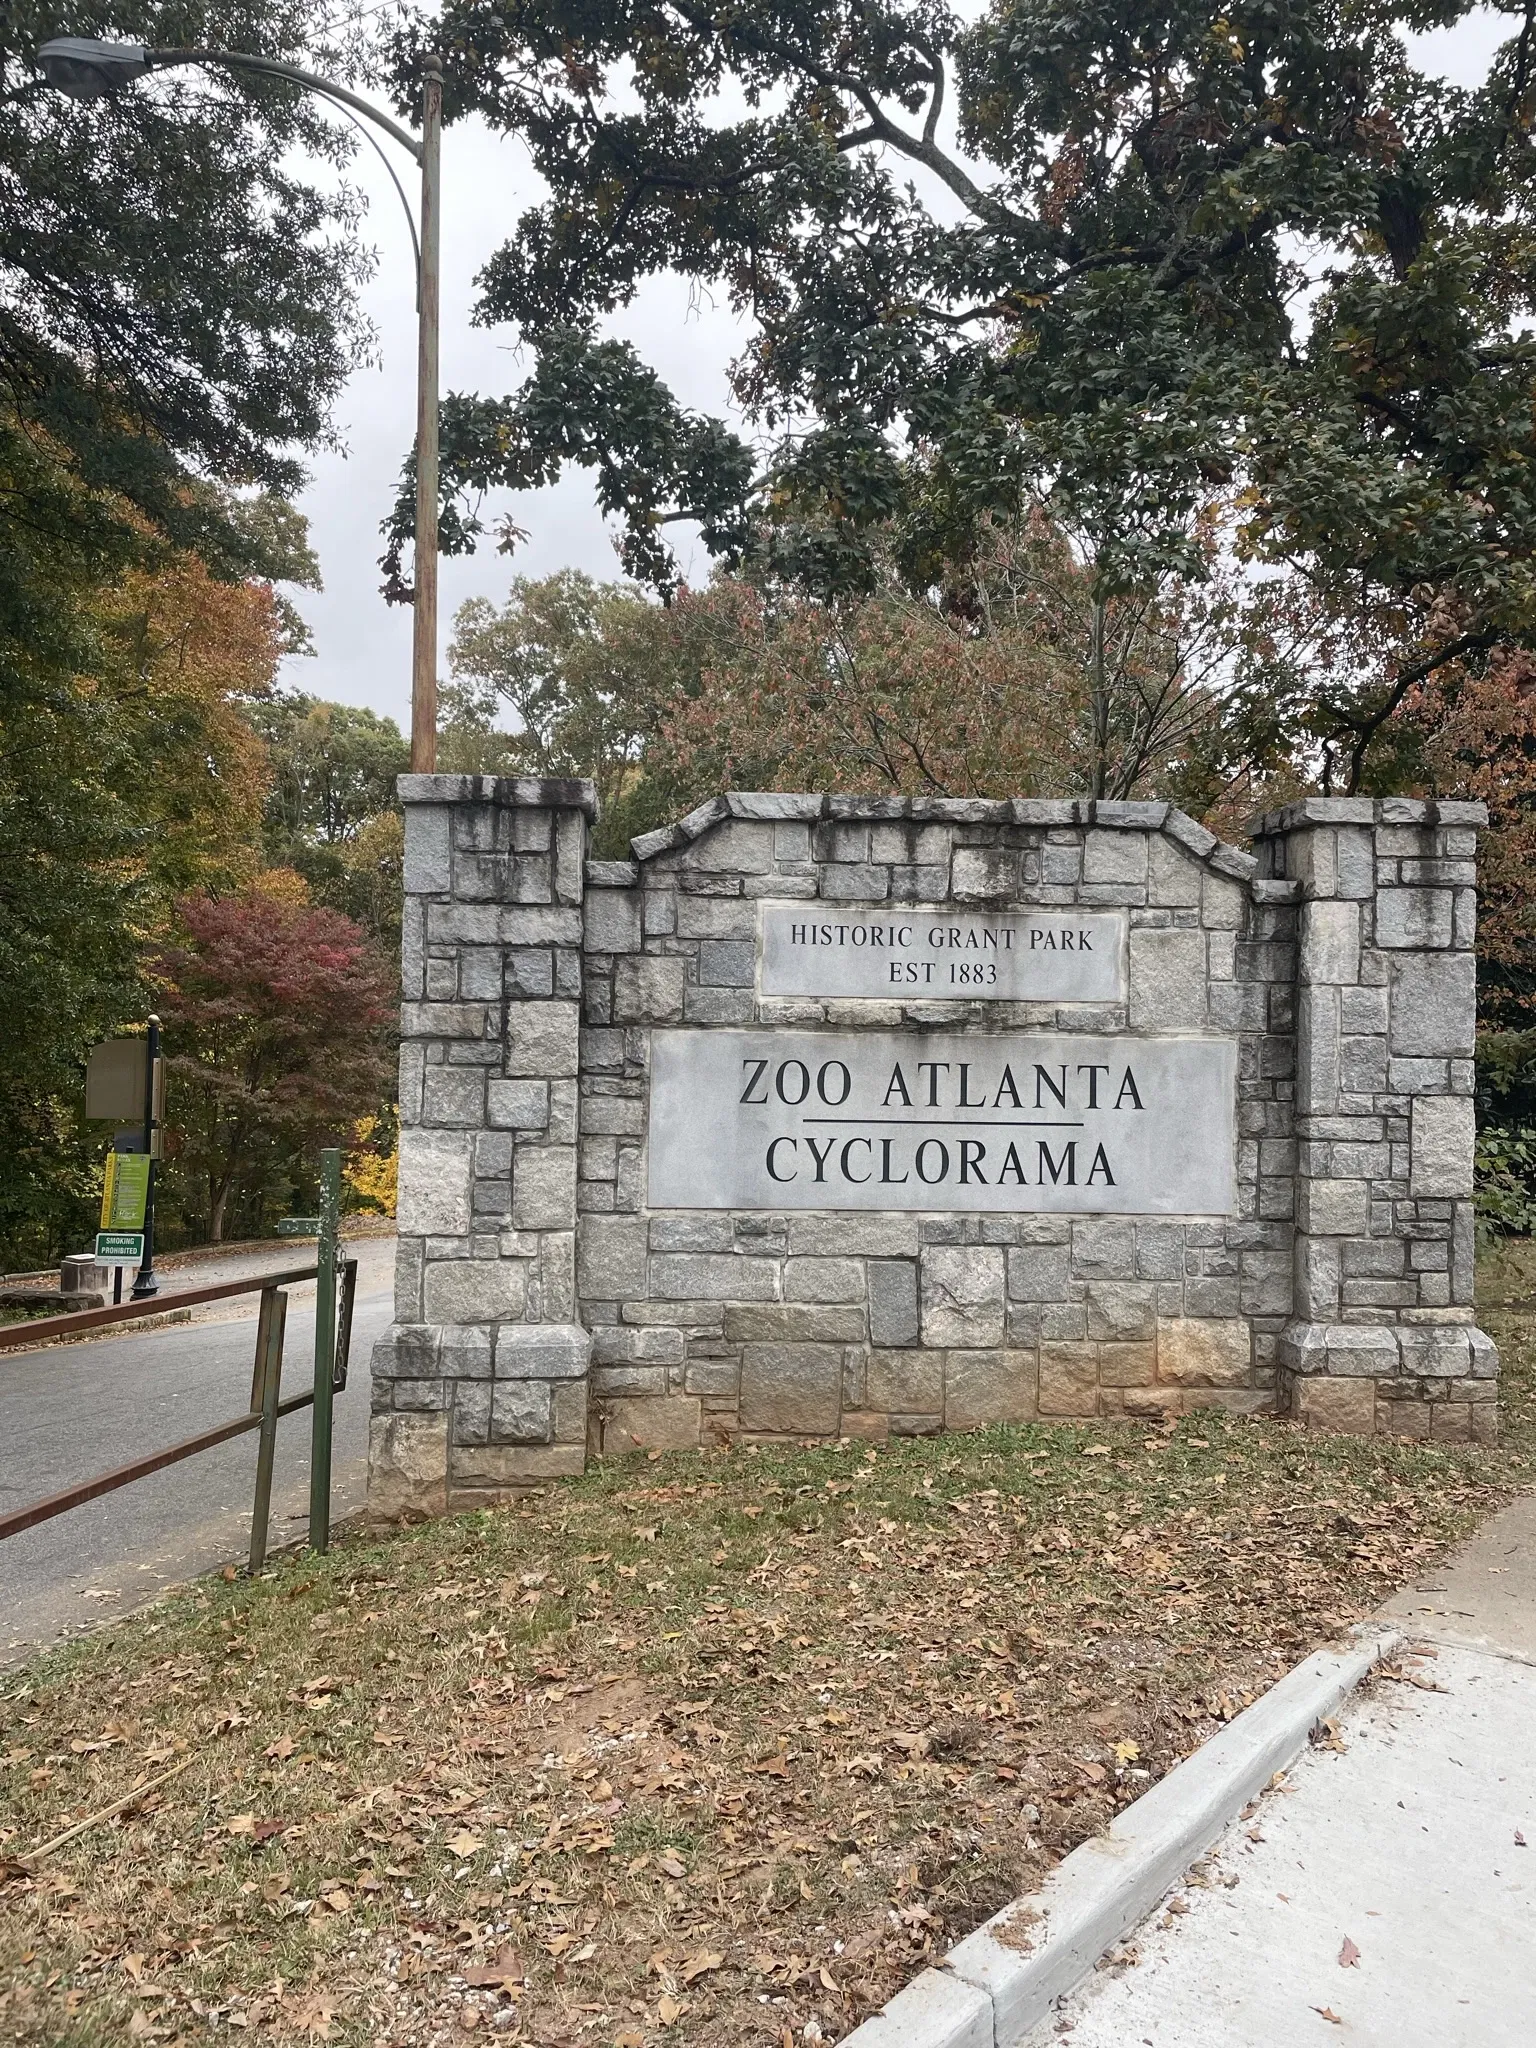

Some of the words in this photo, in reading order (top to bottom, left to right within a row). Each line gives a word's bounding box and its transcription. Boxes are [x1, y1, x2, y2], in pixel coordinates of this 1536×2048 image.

[791, 924, 913, 947] HISTORIC
[929, 928, 1016, 949] GRANT
[1031, 930, 1093, 950] PARK
[889, 962, 935, 983] EST
[950, 964, 998, 984] 1883
[740, 1060, 850, 1105] ZOO
[882, 1062, 1144, 1109] ATLANTA
[766, 1137, 1116, 1185] CYCLORAMA
[101, 1246, 138, 1255] PROHIBITED
[105, 1237, 135, 1245] SMOKING
